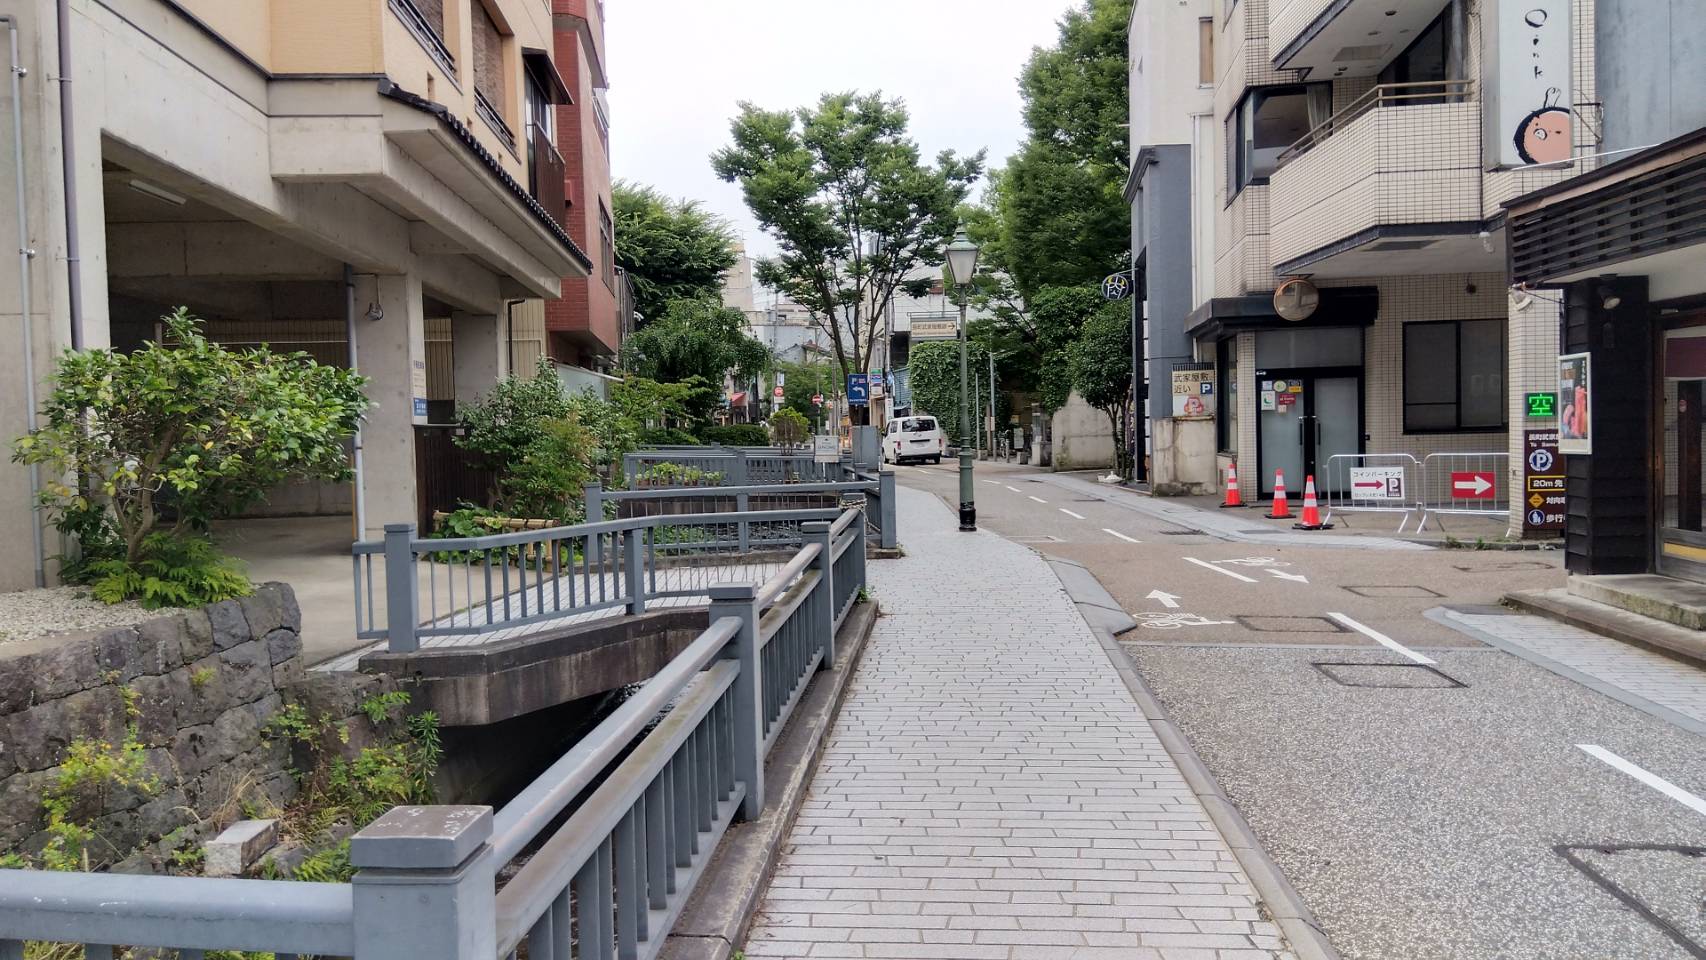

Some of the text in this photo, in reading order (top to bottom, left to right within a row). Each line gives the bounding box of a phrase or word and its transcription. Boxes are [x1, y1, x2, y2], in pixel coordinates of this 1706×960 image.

[1524, 8, 1548, 79] Oink
[1202, 383, 1211, 394] P
[1528, 393, 1553, 416] 空
[1533, 480, 1554, 488] 20m
[1546, 513, 1566, 523] 歩行
